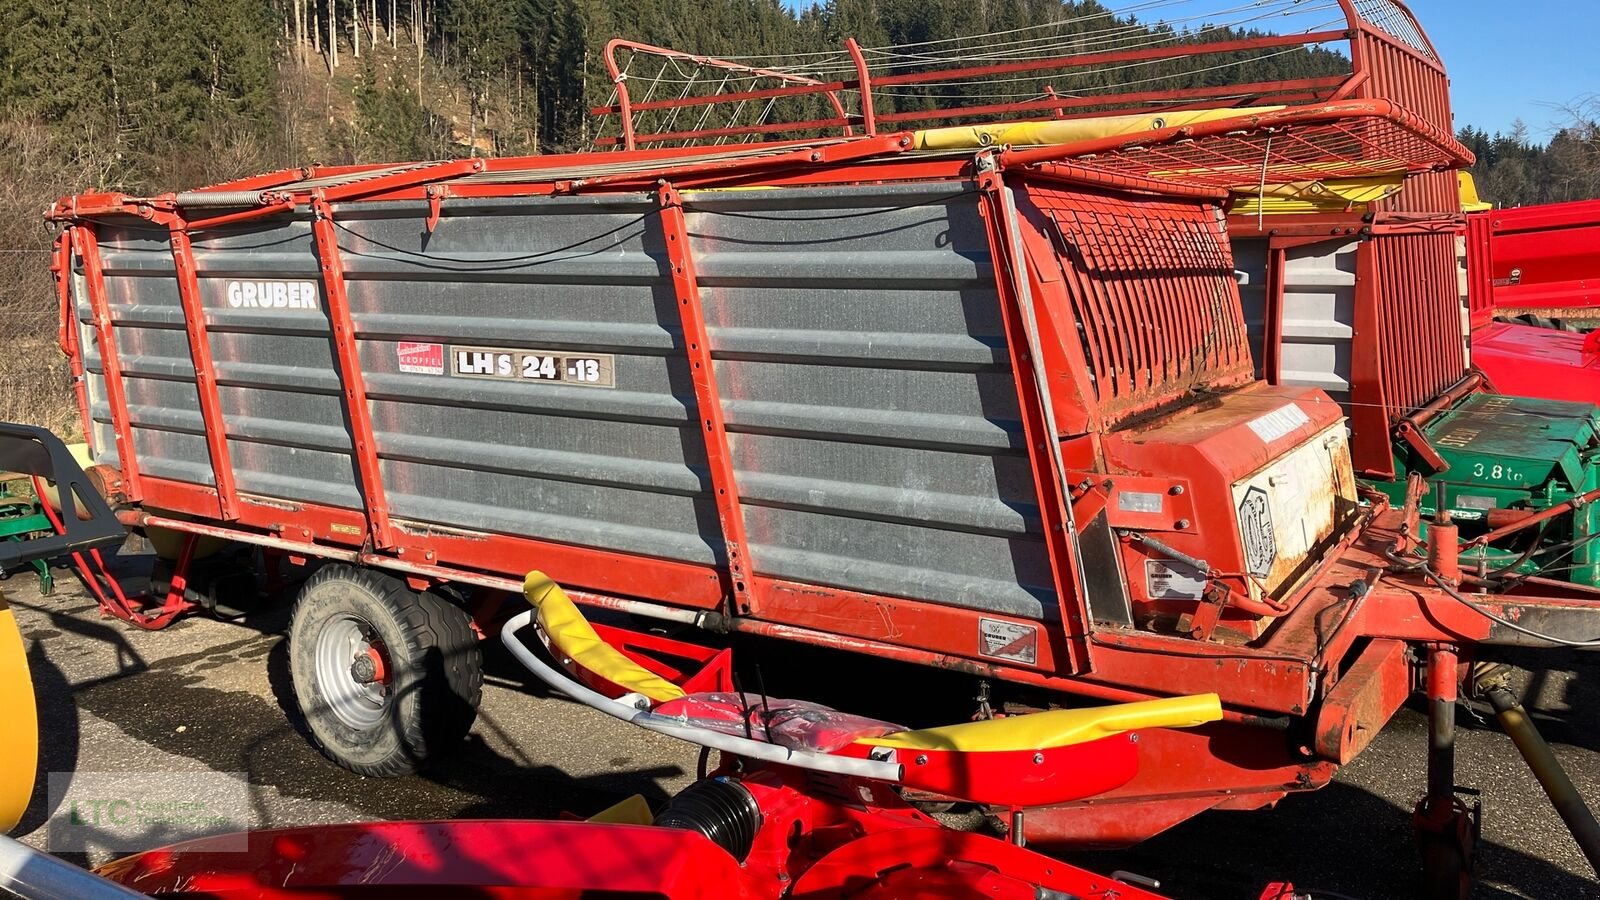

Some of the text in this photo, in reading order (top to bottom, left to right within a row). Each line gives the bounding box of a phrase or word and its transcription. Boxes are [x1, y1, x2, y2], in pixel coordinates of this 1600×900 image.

[227, 281, 317, 309] GRUBER
[522, 356, 556, 379] 24
[567, 359, 600, 382] -13
